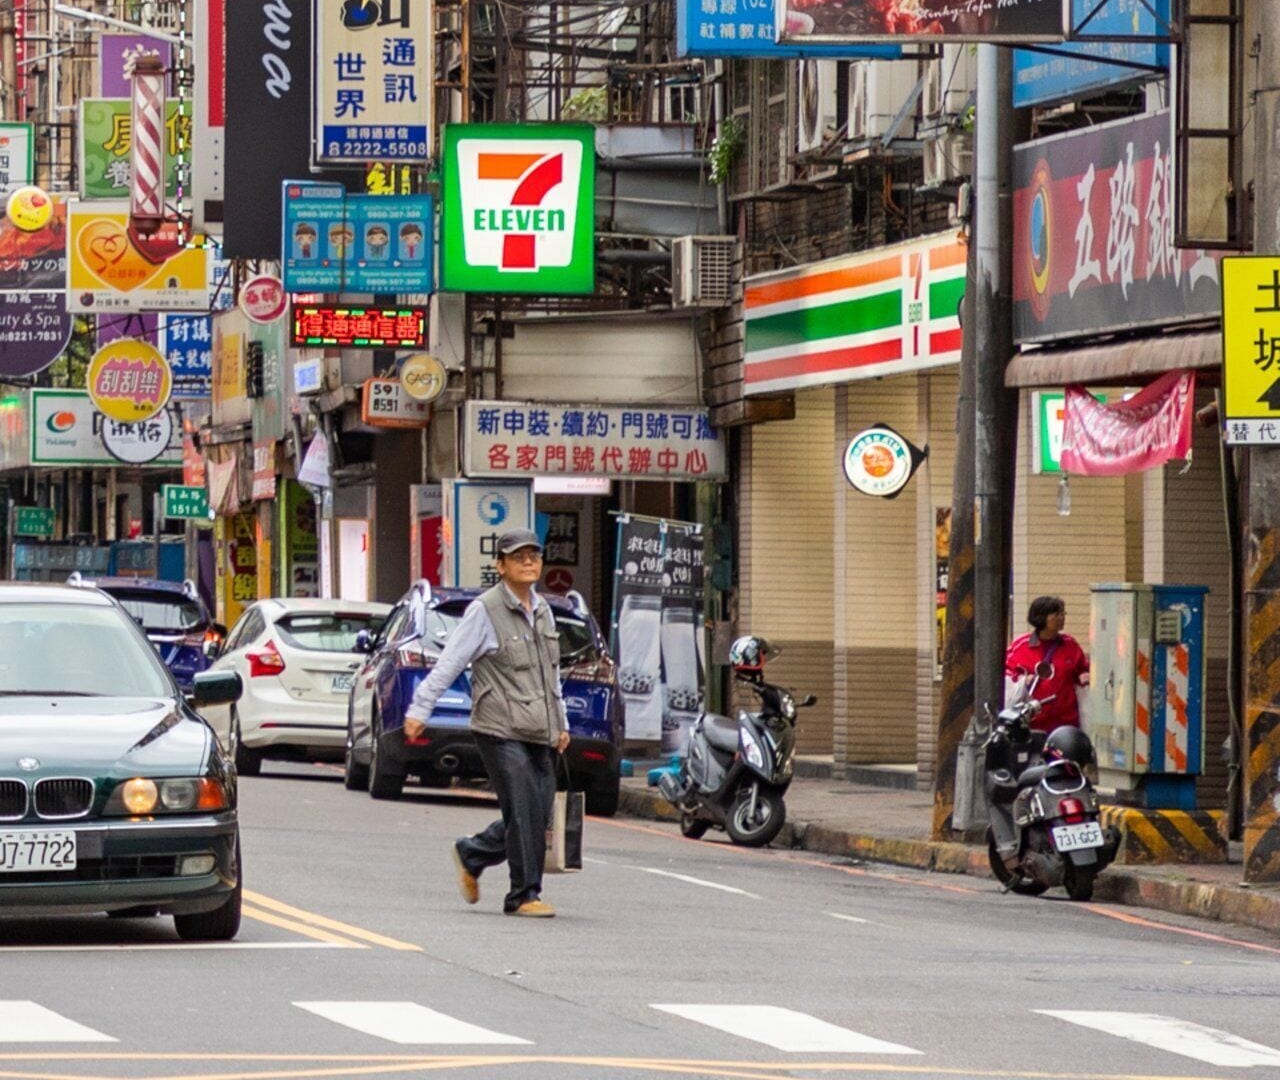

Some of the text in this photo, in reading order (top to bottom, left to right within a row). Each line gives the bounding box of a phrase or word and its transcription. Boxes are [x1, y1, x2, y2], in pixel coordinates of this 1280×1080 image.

[333, 50, 367, 119] 世界
[1068, 140, 1220, 302] 五路鍋
[19, 313, 32, 326] &
[35, 313, 61, 328] Spa
[100, 369, 159, 394] 刮刮樂
[1232, 422, 1278, 442] 替代
